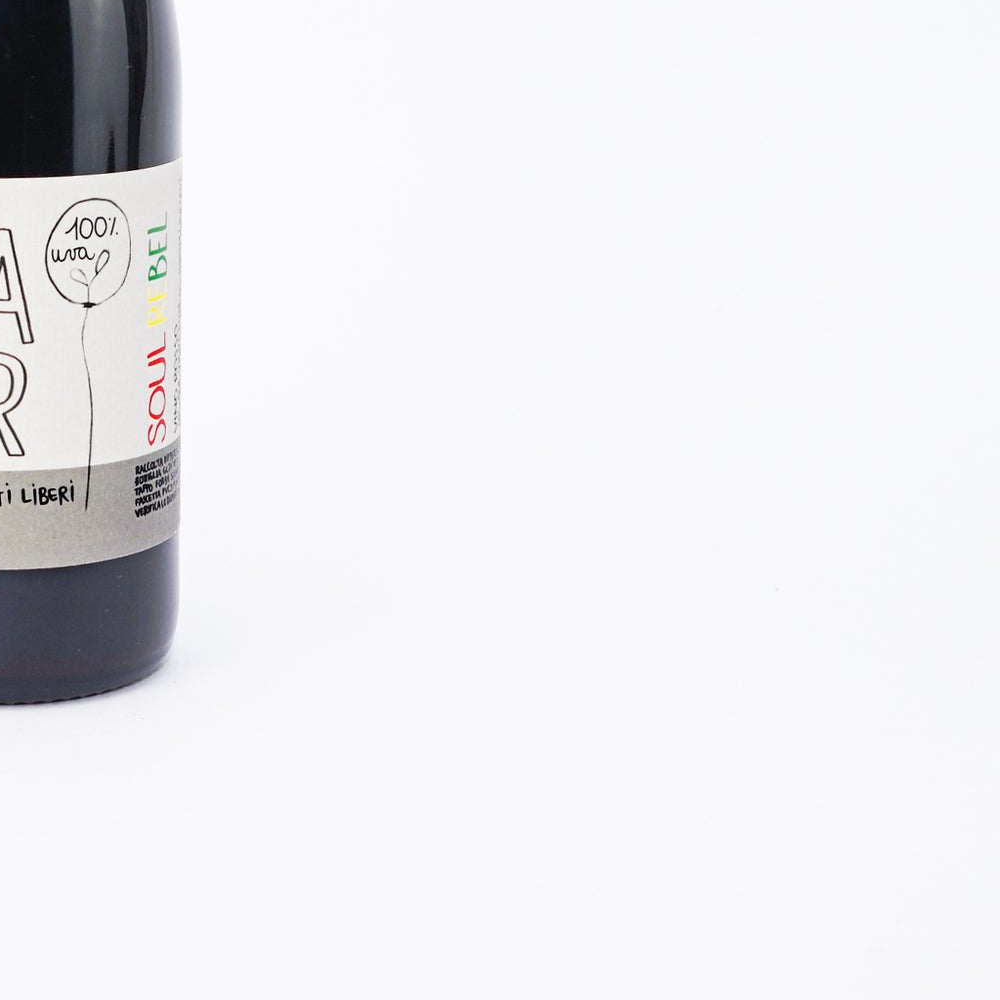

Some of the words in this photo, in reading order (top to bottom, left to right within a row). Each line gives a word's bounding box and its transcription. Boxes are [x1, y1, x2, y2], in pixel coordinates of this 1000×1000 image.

[51, 246, 95, 263] uva
[65, 216, 119, 240] 100%
[147, 210, 168, 327] REBEL
[147, 332, 167, 446] SOUL
